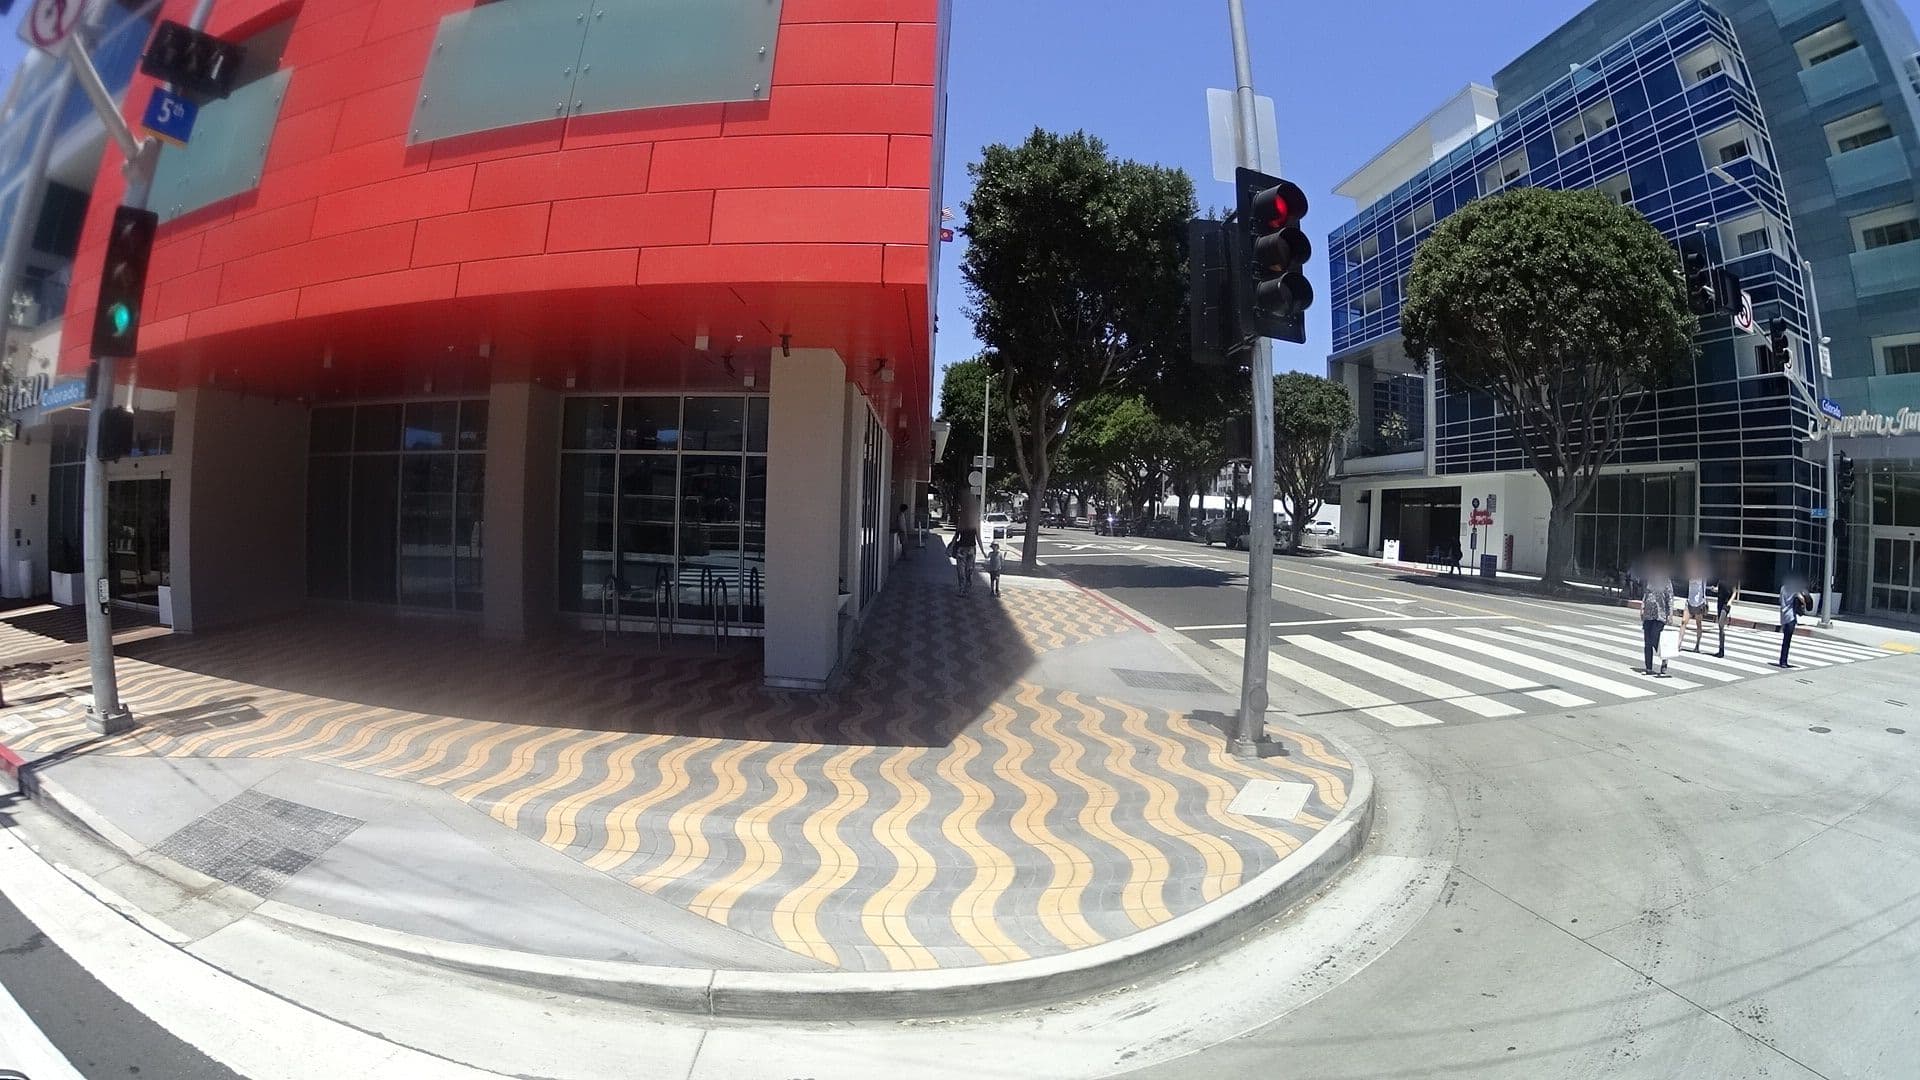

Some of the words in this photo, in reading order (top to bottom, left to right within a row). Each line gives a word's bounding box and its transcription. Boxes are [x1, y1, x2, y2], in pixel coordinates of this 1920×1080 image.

[157, 98, 185, 122] 5th
[41, 383, 79, 407] Colorado
[1822, 400, 1842, 418] Colorado
